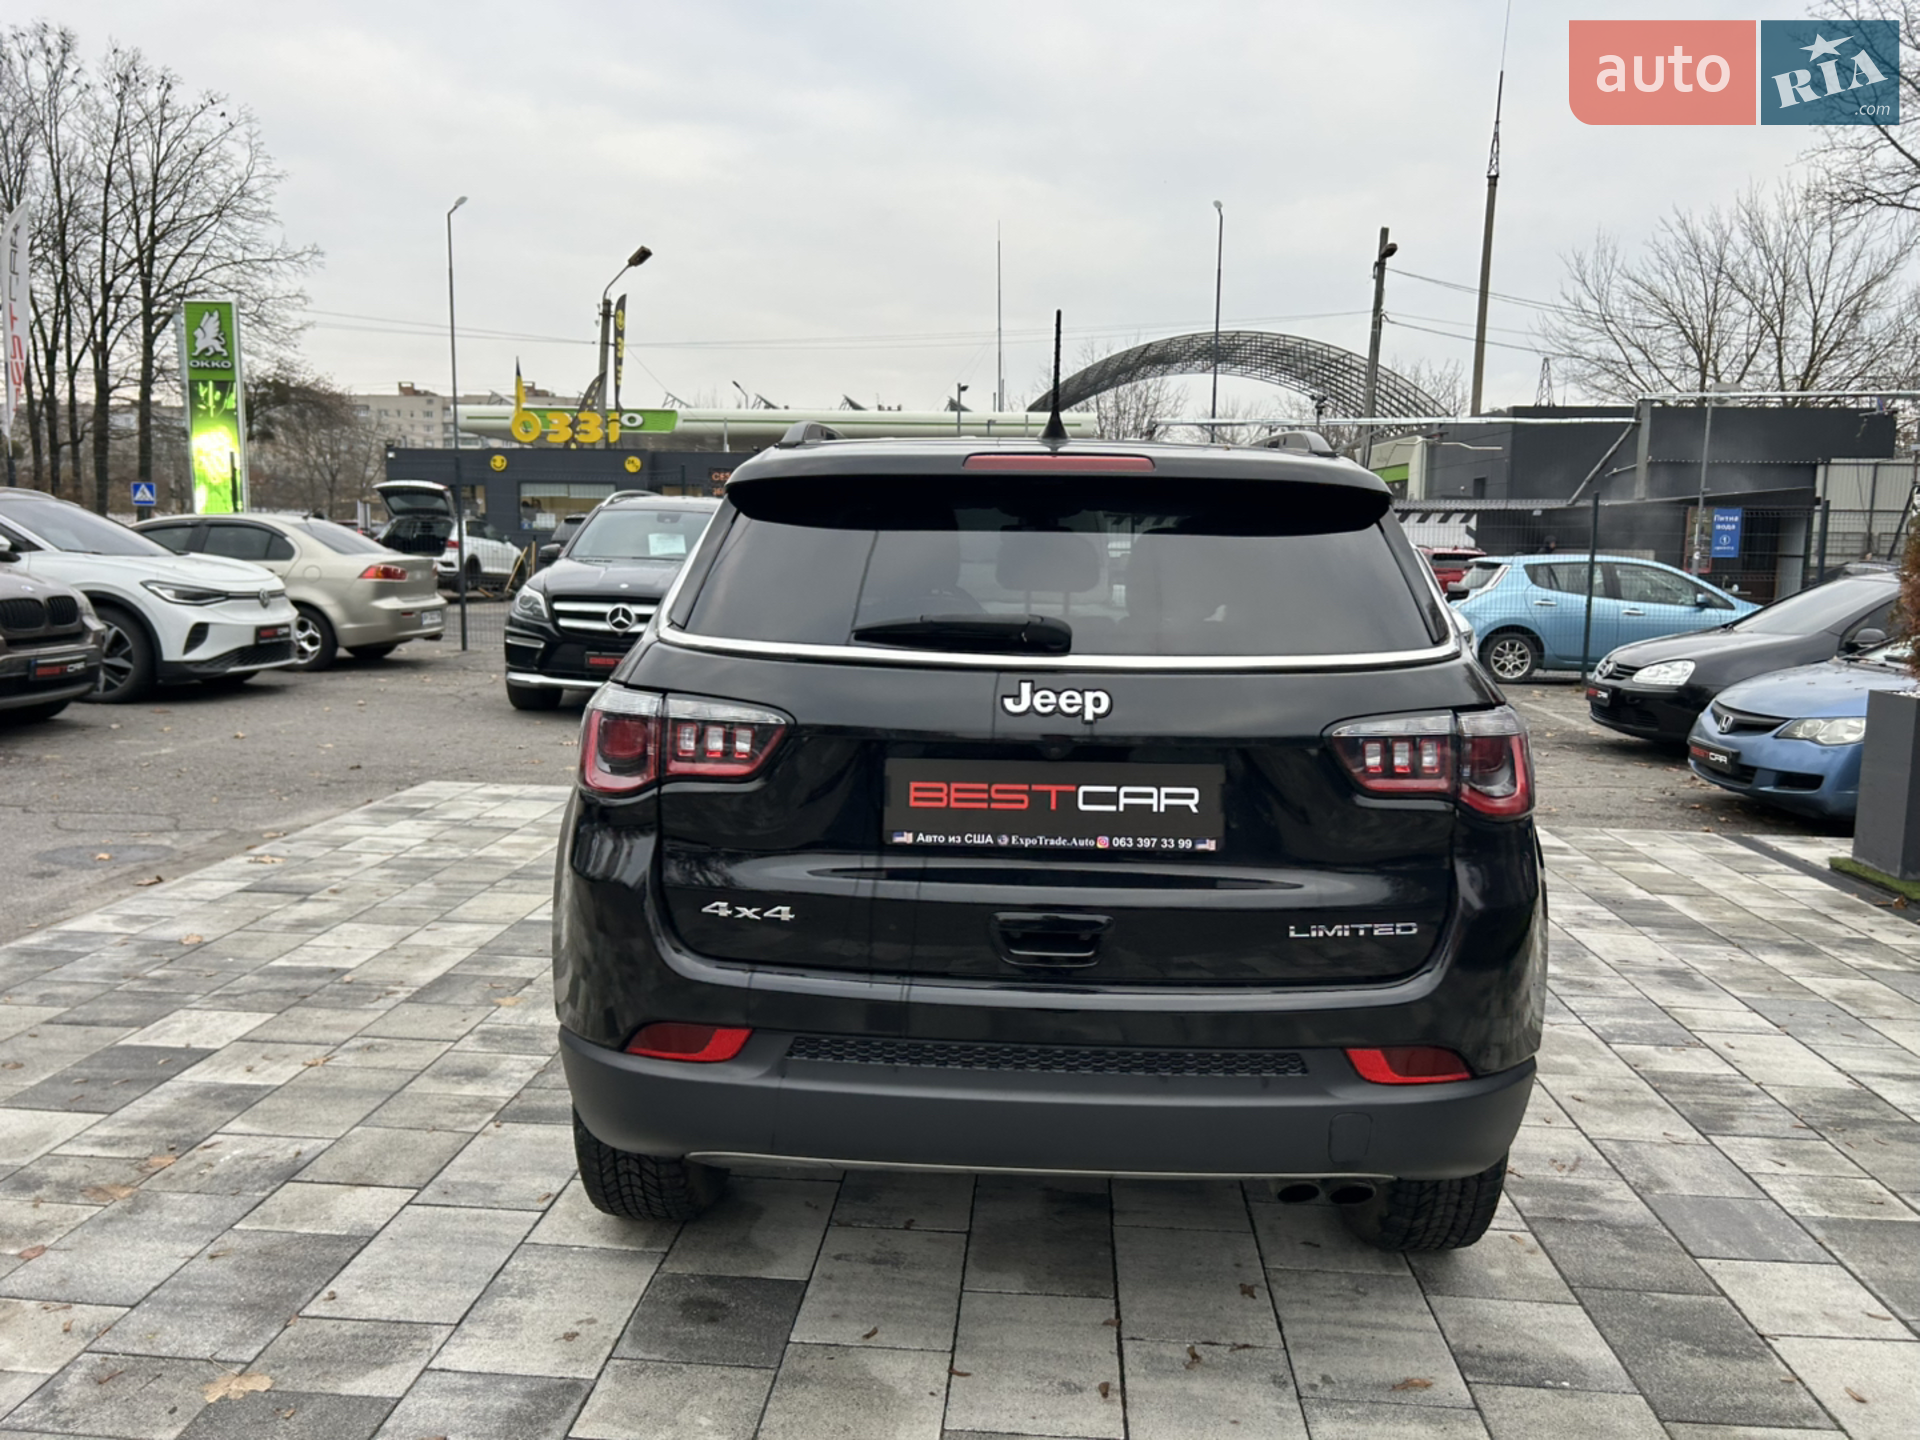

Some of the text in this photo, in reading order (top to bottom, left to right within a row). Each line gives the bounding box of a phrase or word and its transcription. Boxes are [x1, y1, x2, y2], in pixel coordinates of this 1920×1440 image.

[189, 360, 232, 369] OKKO
[1002, 680, 1112, 723] Jeep
[916, 832, 1192, 848] Авто из США ExpoTrade.Auto 063 397 33 99
[701, 901, 795, 921] 4x4
[1289, 922, 1418, 937] LIMITED
